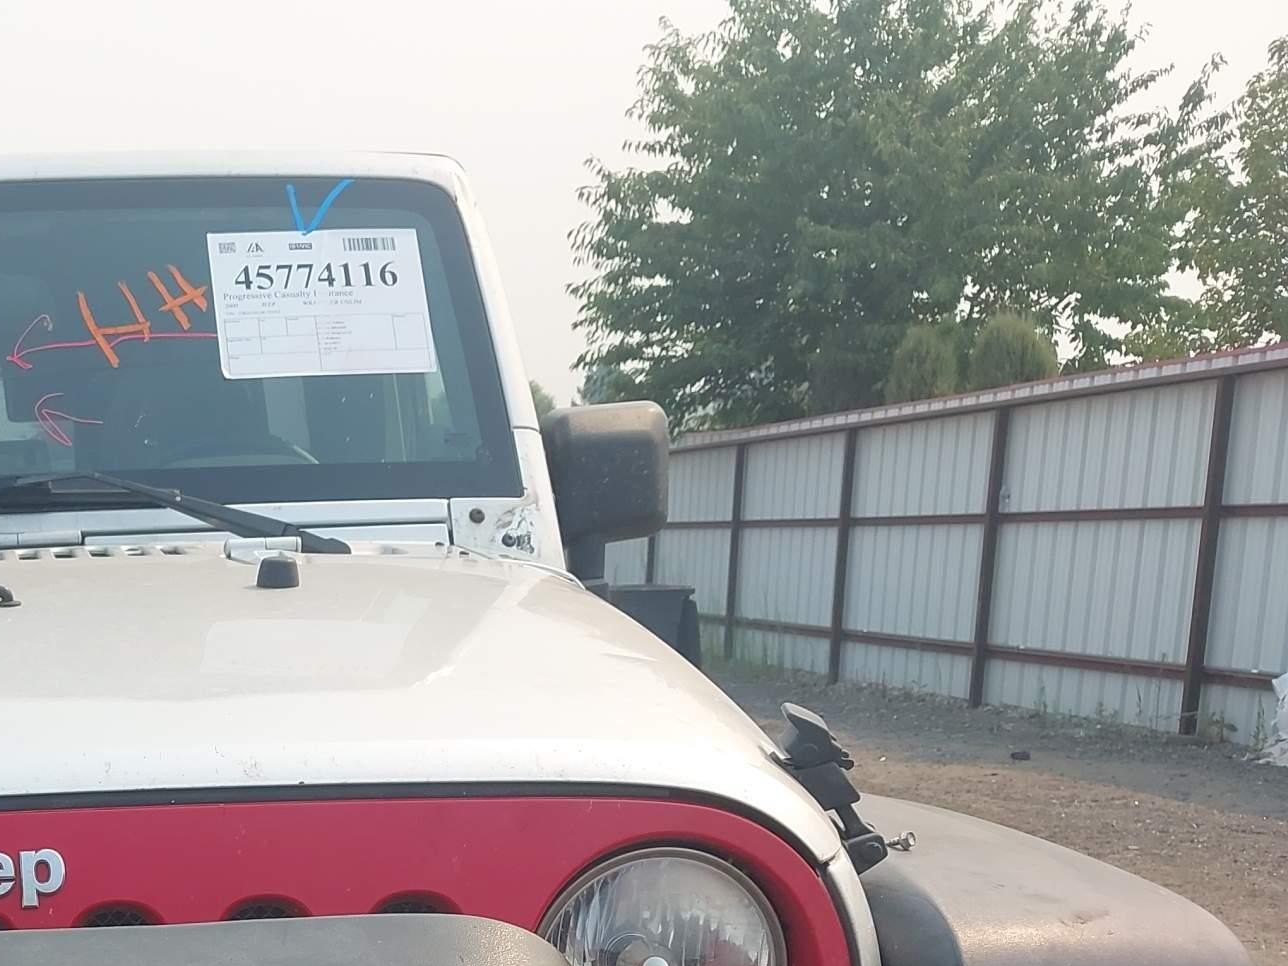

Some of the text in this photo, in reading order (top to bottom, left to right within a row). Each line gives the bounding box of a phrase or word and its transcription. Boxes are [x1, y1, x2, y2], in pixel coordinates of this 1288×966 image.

[234, 261, 399, 290] 45774116
[223, 292, 272, 302] Progressive
[273, 289, 312, 300] Casualty
